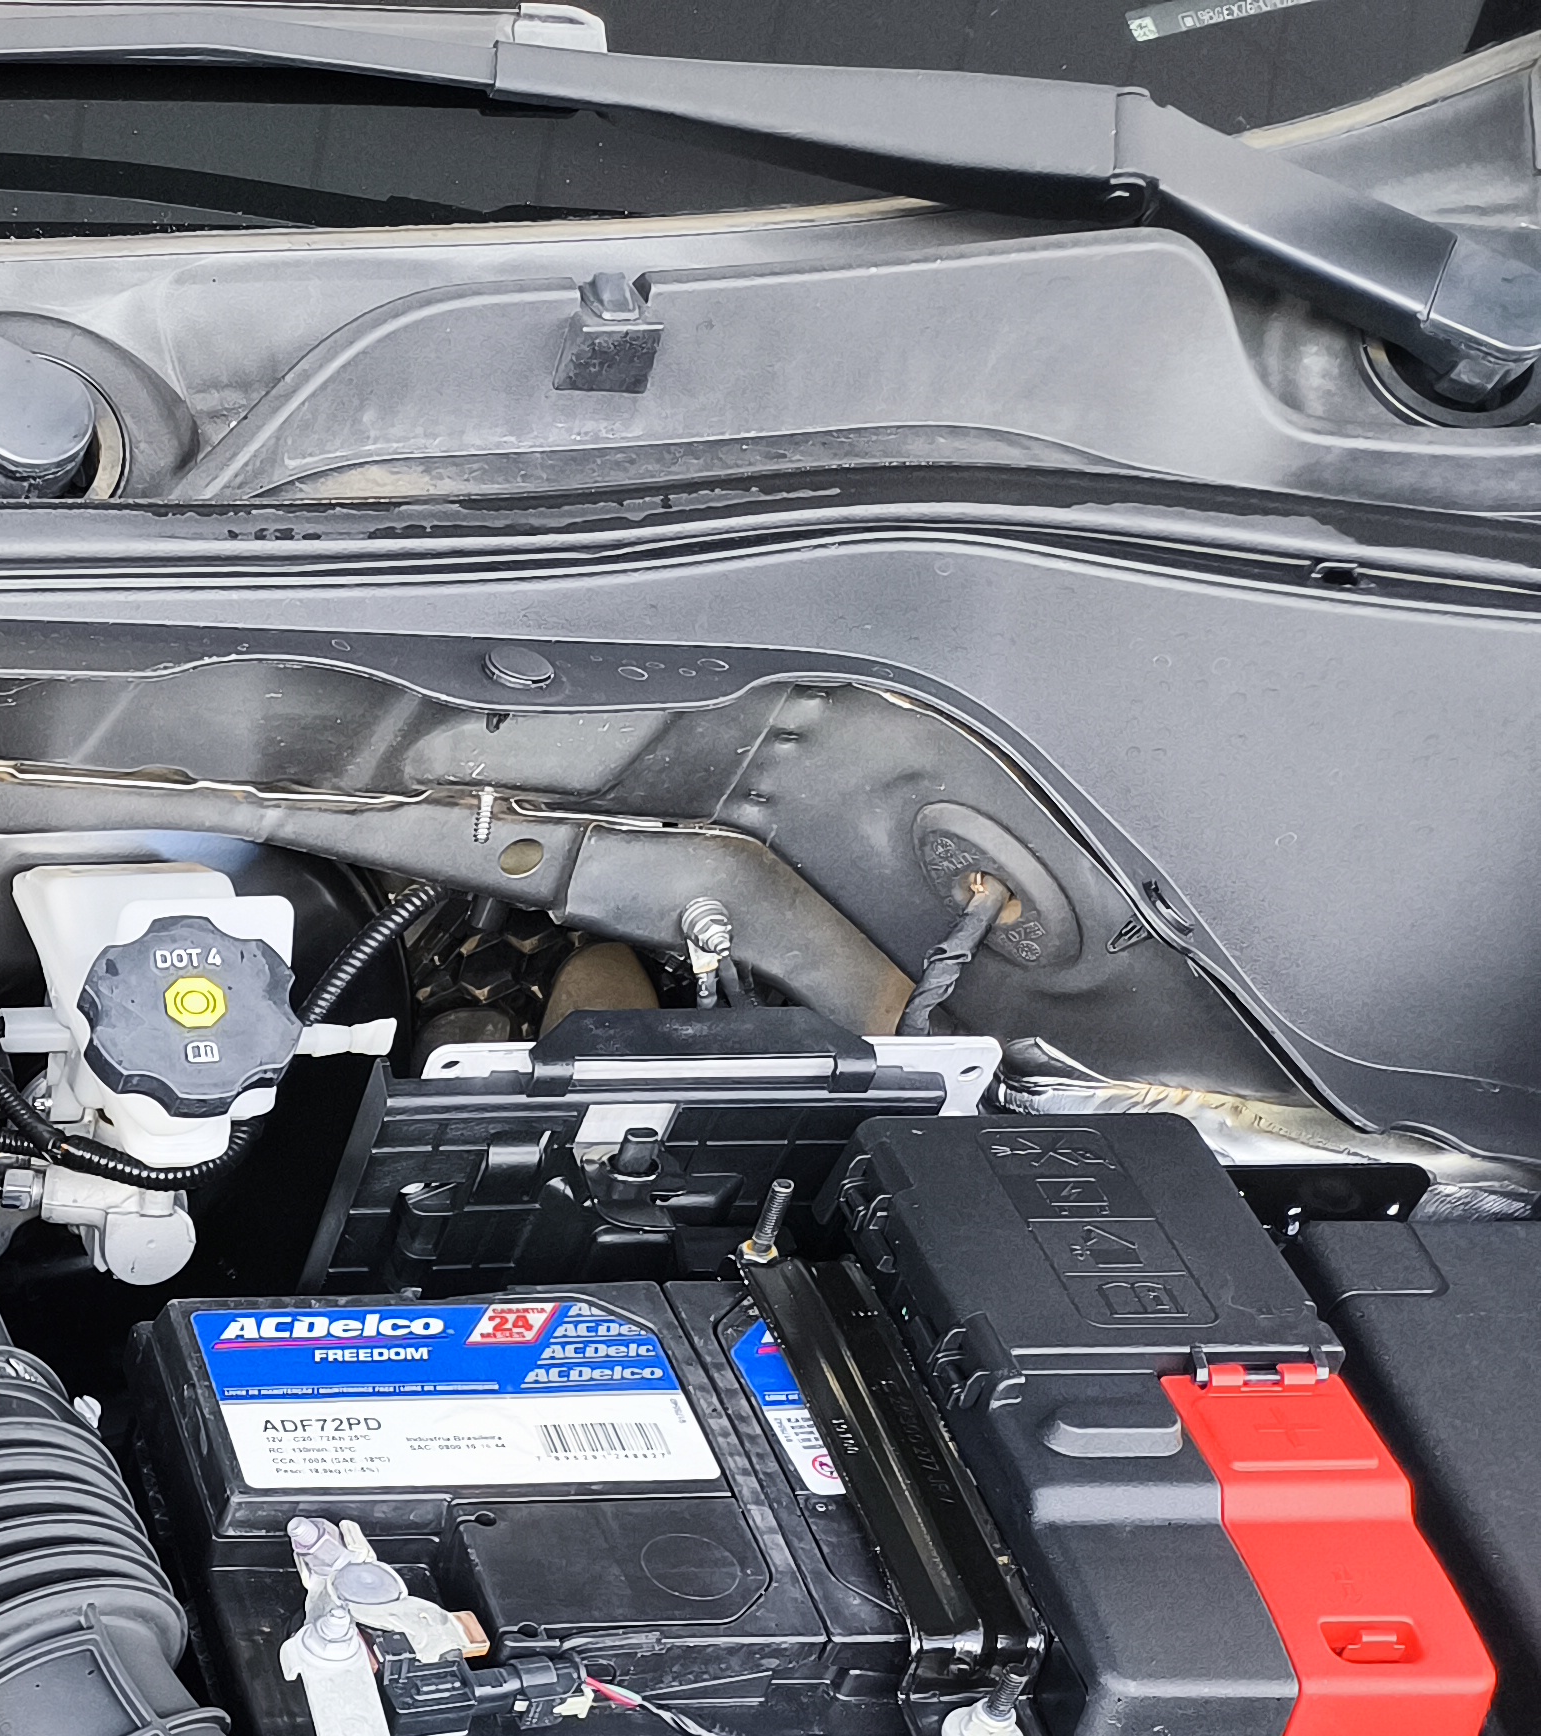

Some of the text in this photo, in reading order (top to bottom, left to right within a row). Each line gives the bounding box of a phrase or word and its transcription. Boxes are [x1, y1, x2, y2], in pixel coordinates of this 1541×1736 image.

[155, 947, 222, 969] DOT 4
[219, 1313, 445, 1340] ACDelco
[488, 1316, 534, 1332] 24
[314, 1347, 429, 1362] FREEDOM
[524, 1366, 664, 1382] ACDelco
[262, 1417, 382, 1433] ADF72PD
